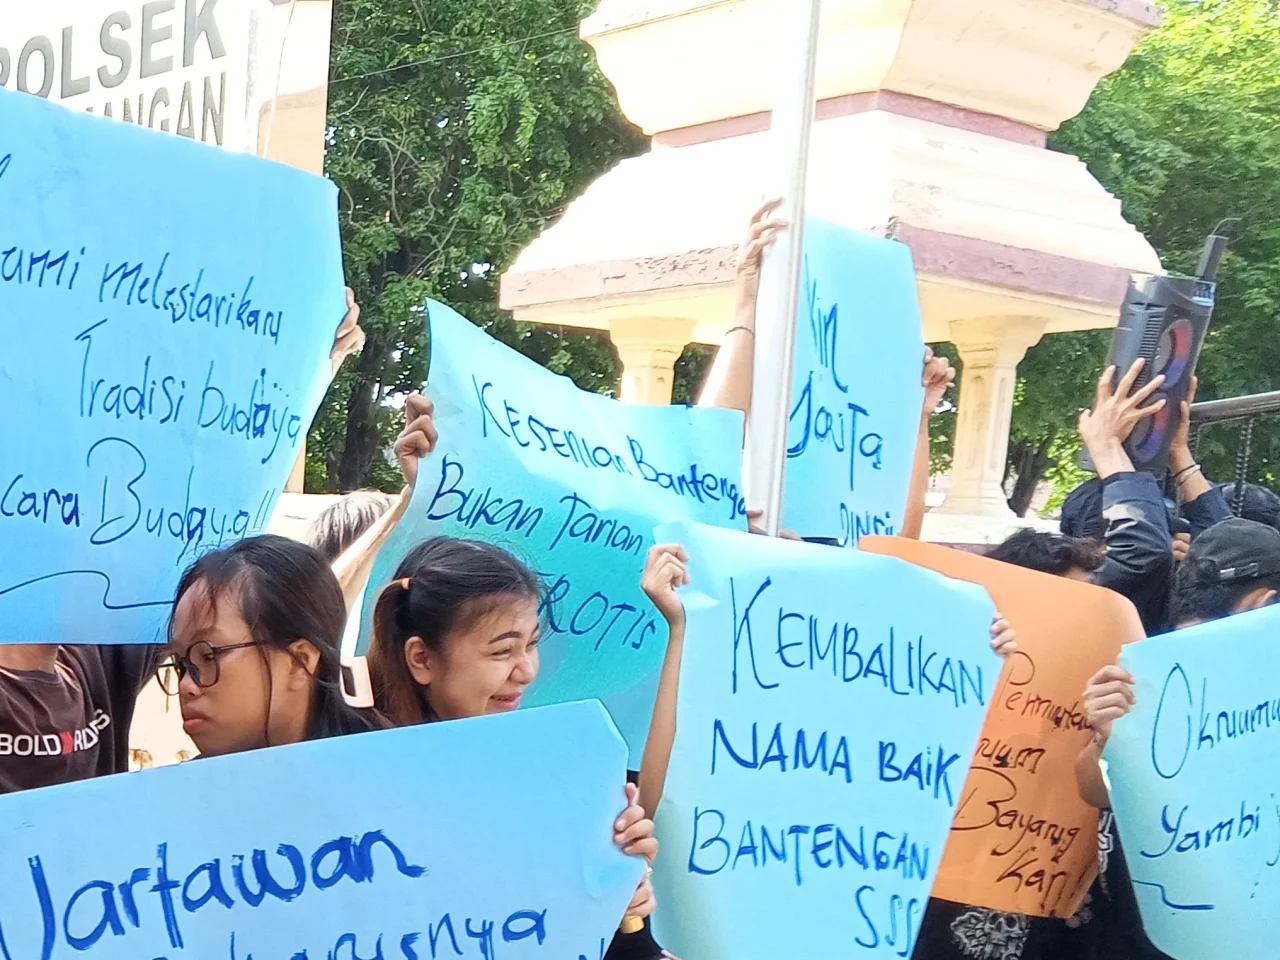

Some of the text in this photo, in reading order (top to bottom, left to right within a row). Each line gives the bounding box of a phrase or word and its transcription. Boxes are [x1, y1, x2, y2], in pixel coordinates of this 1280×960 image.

[729, 575, 985, 708] KEMBALIKAN
[710, 717, 854, 785] NAMA
[688, 806, 930, 887] BANTENGAN
